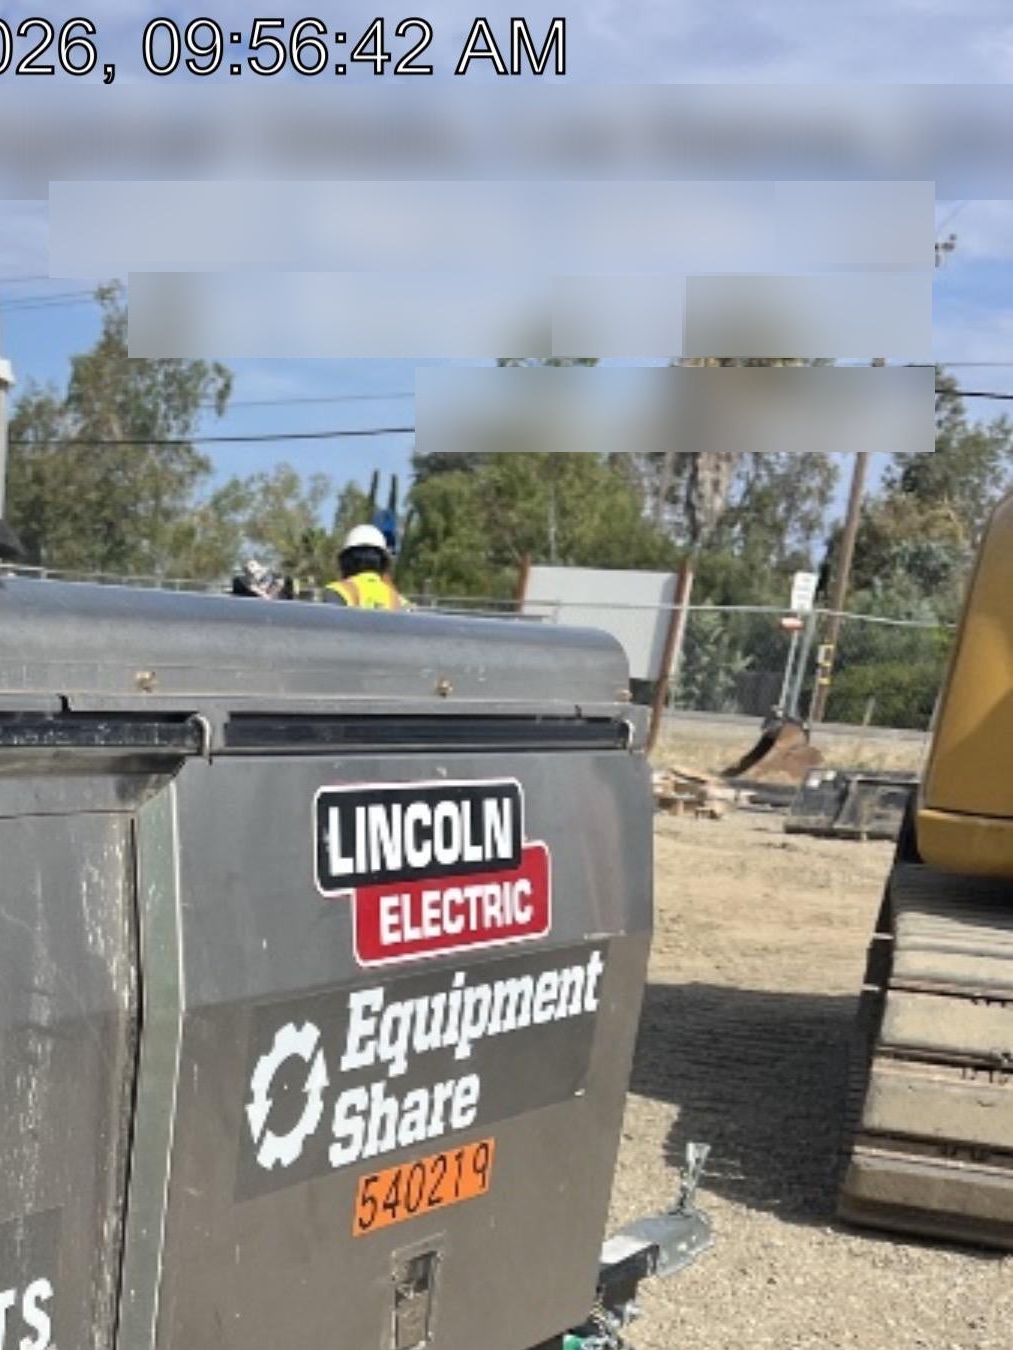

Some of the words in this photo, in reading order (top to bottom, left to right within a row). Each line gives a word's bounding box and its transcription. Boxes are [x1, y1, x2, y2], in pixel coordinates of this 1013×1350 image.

[323, 797, 514, 877] LINCOLN
[379, 878, 534, 946] ELECTRIC
[340, 950, 605, 1078] Equipment
[328, 1073, 481, 1168] Share
[358, 1143, 490, 1230] 540219
